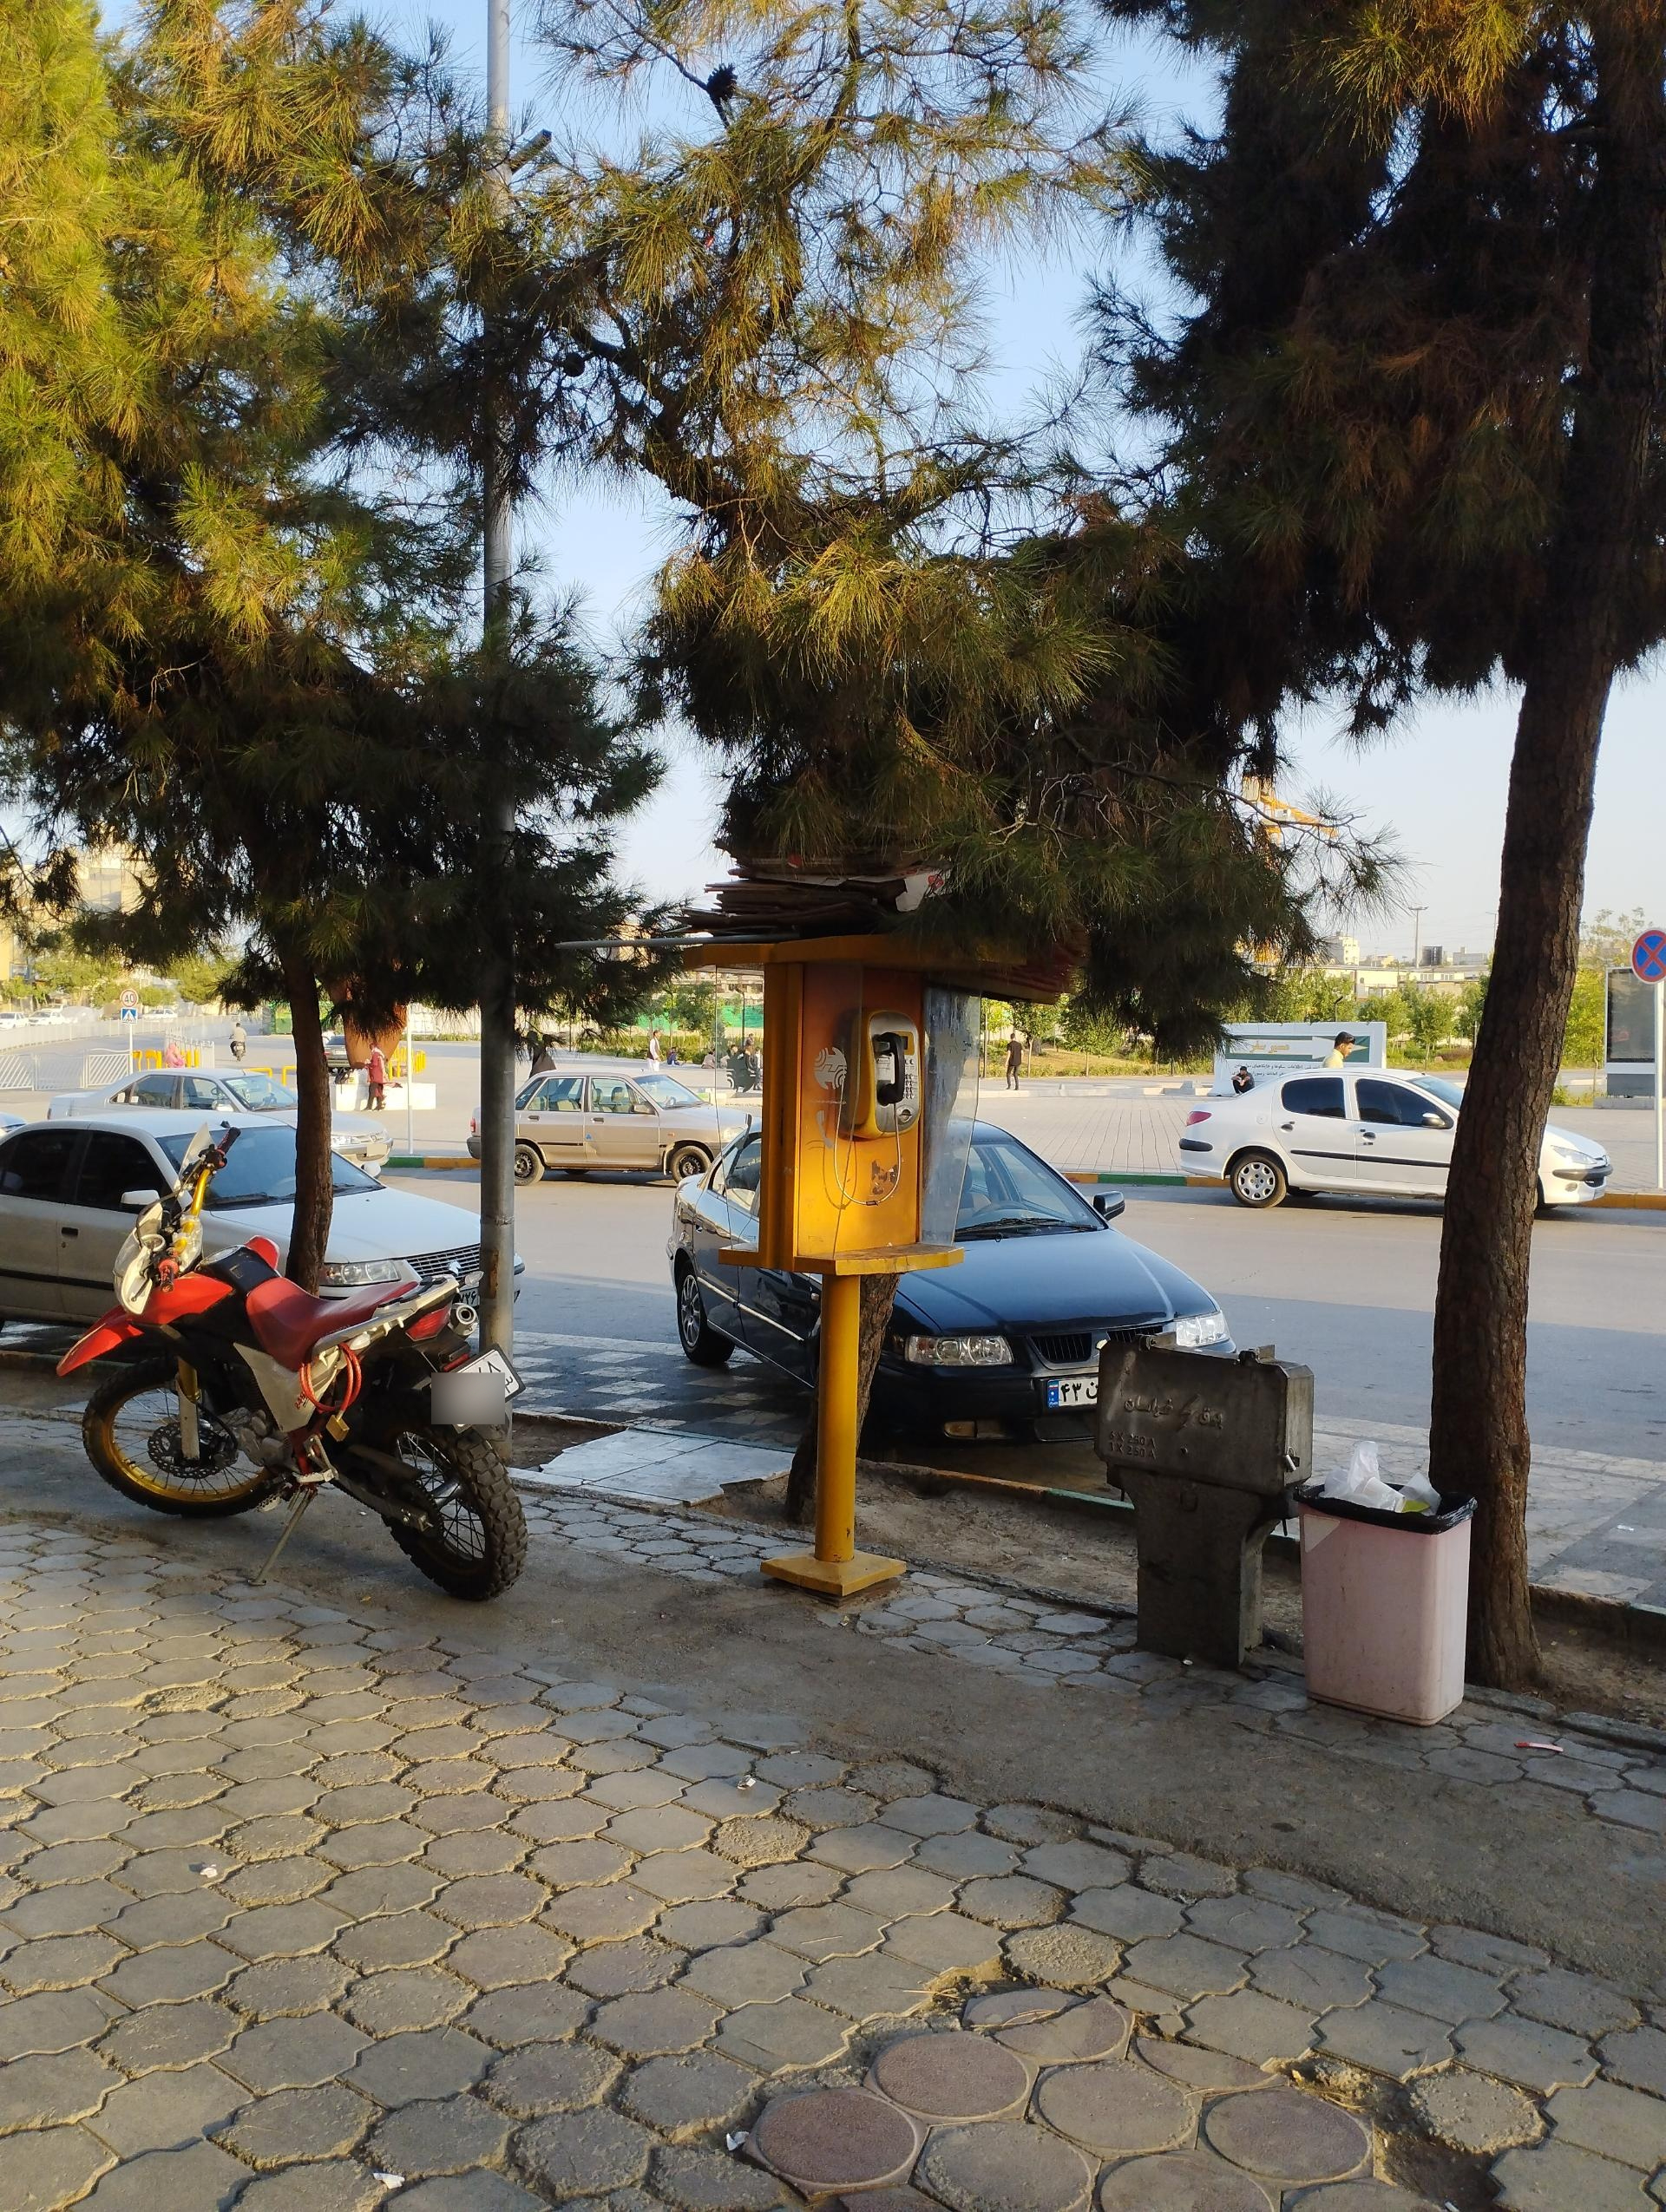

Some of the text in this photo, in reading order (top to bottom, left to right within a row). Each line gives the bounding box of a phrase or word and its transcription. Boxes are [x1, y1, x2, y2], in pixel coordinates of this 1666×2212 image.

[124, 991, 135, 1003] 40
[1060, 1383, 1082, 1403] ۴۳
[1125, 1394, 1224, 1430] برق خراسان
[1125, 1433, 1146, 1446] 250
[1146, 1436, 1157, 1450] A
[1125, 1443, 1146, 1458] 250
[1145, 1449, 1157, 1461] A
